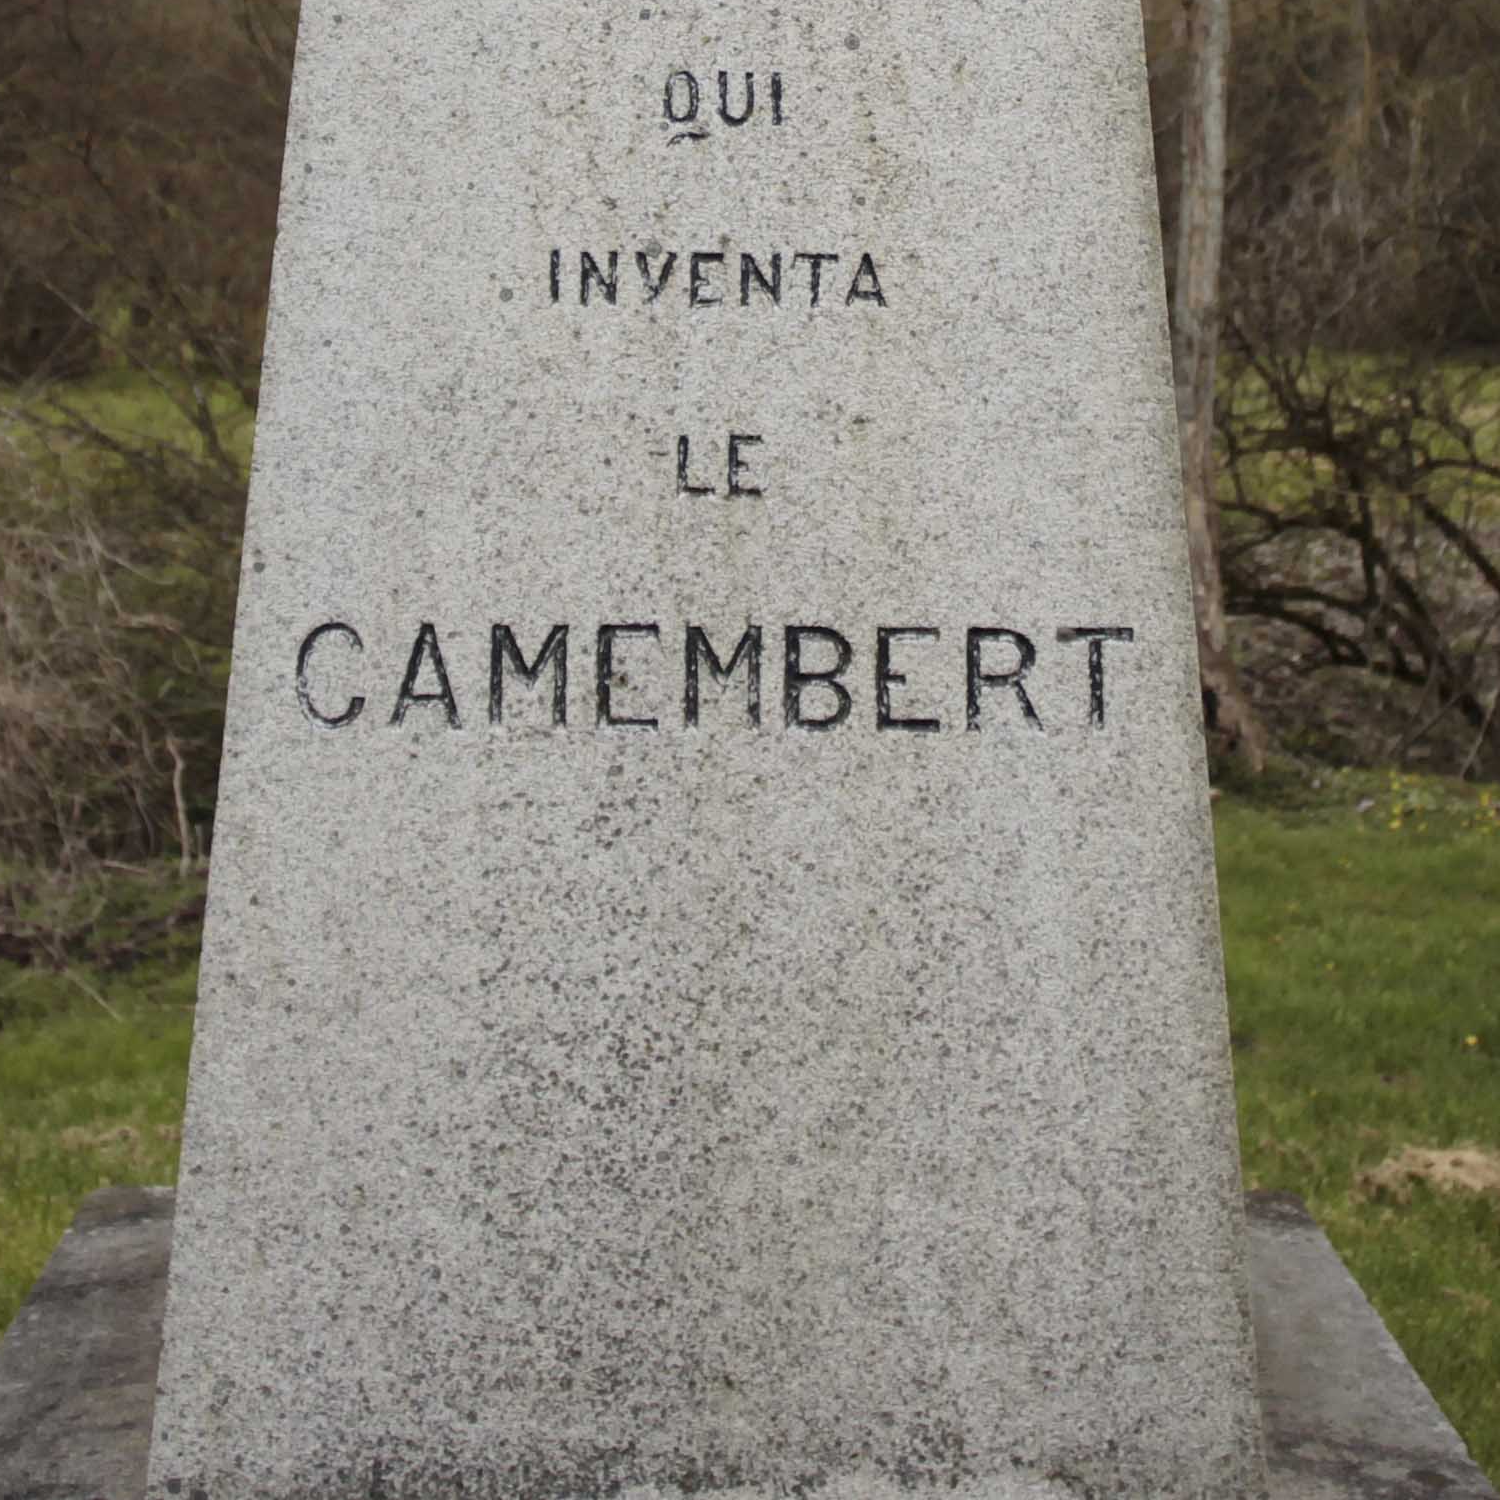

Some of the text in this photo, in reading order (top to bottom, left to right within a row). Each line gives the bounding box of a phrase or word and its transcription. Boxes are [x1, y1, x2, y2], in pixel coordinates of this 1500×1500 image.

[661, 69, 784, 146] QUI
[548, 248, 890, 309] INVENTA
[675, 433, 766, 499] LE
[296, 620, 1135, 733] CAMEMBERT
